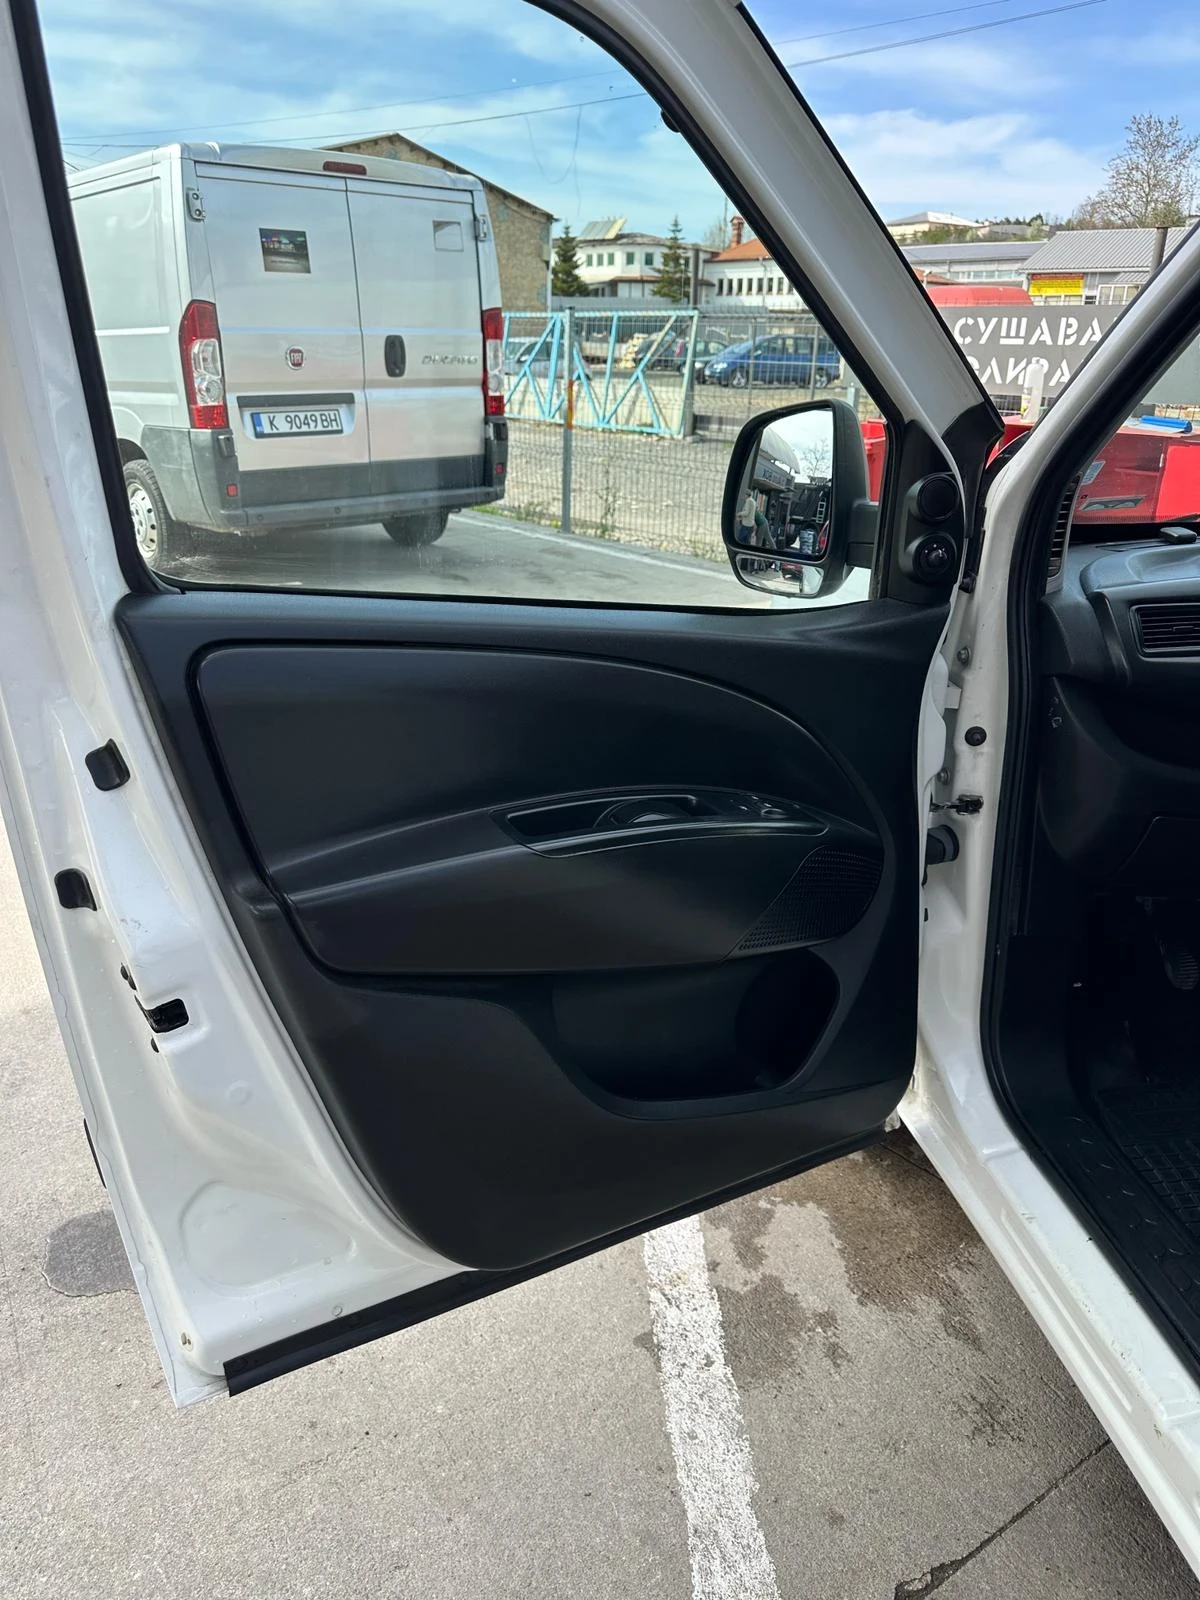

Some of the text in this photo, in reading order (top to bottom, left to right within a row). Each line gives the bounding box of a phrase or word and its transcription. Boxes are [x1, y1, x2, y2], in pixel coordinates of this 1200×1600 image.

[953, 316, 1117, 346] СУШАВА
[268, 415, 279, 431] K
[285, 413, 318, 431] 9049
